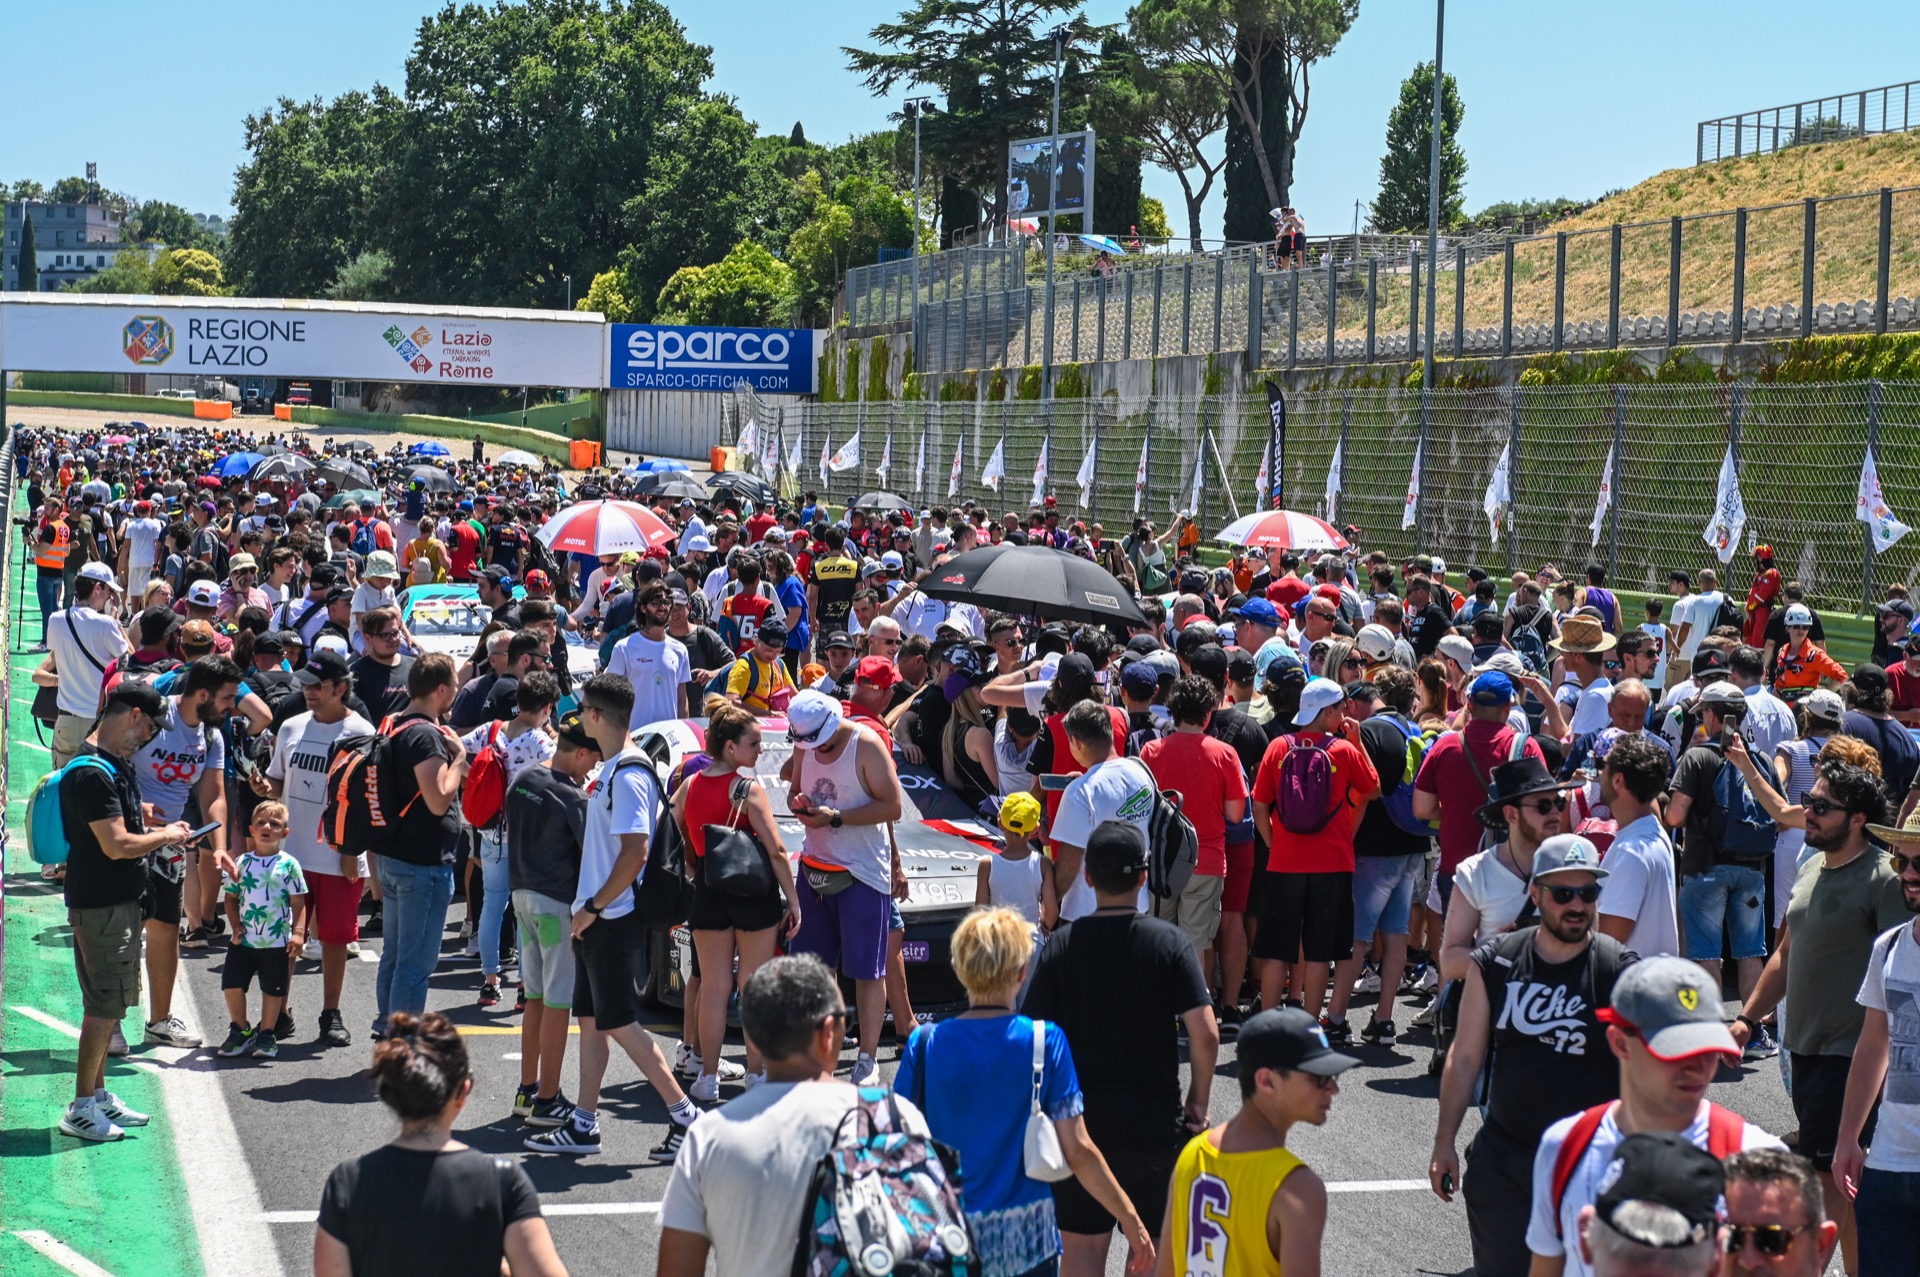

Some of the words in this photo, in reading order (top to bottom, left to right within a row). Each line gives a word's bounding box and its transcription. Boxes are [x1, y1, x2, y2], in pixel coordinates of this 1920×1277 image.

[189, 318, 306, 342] REGIONE
[442, 329, 492, 346] Lazio
[188, 345, 268, 366] LAZIO
[627, 330, 790, 370] sparco
[439, 362, 493, 379] Rome
[627, 373, 788, 389] SPARCO-OFFICIAL.COM
[563, 537, 586, 546] MOTUL
[1257, 535, 1281, 543] MOTUL
[808, 872, 830, 885] NIKE
[902, 943, 926, 956] sier
[1496, 981, 1588, 1036] Nike
[1554, 1029, 1587, 1055] 72
